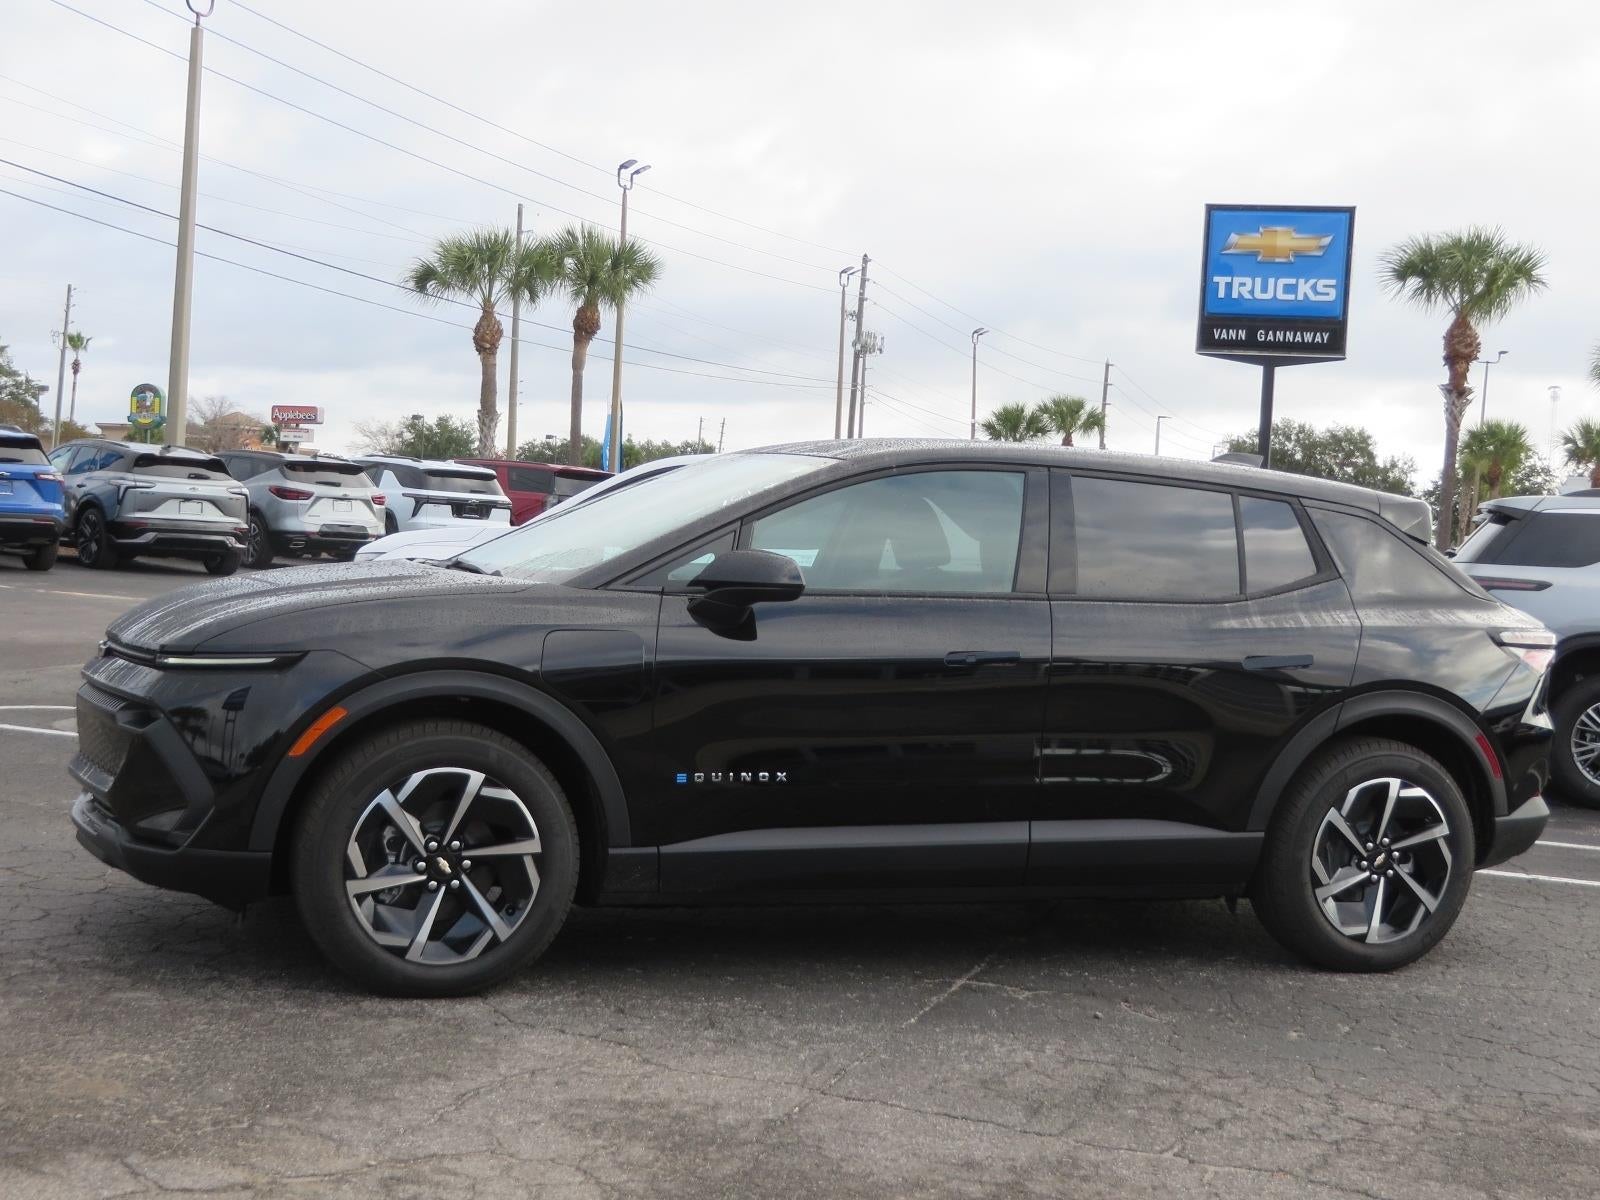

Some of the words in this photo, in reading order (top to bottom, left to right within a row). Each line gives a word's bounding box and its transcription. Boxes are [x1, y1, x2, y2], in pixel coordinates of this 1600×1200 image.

[1212, 276, 1337, 302] TRUCKS
[1213, 328, 1246, 341] VANN
[1257, 330, 1330, 344] GANNAWAY
[676, 772, 787, 783] EQUINOX
